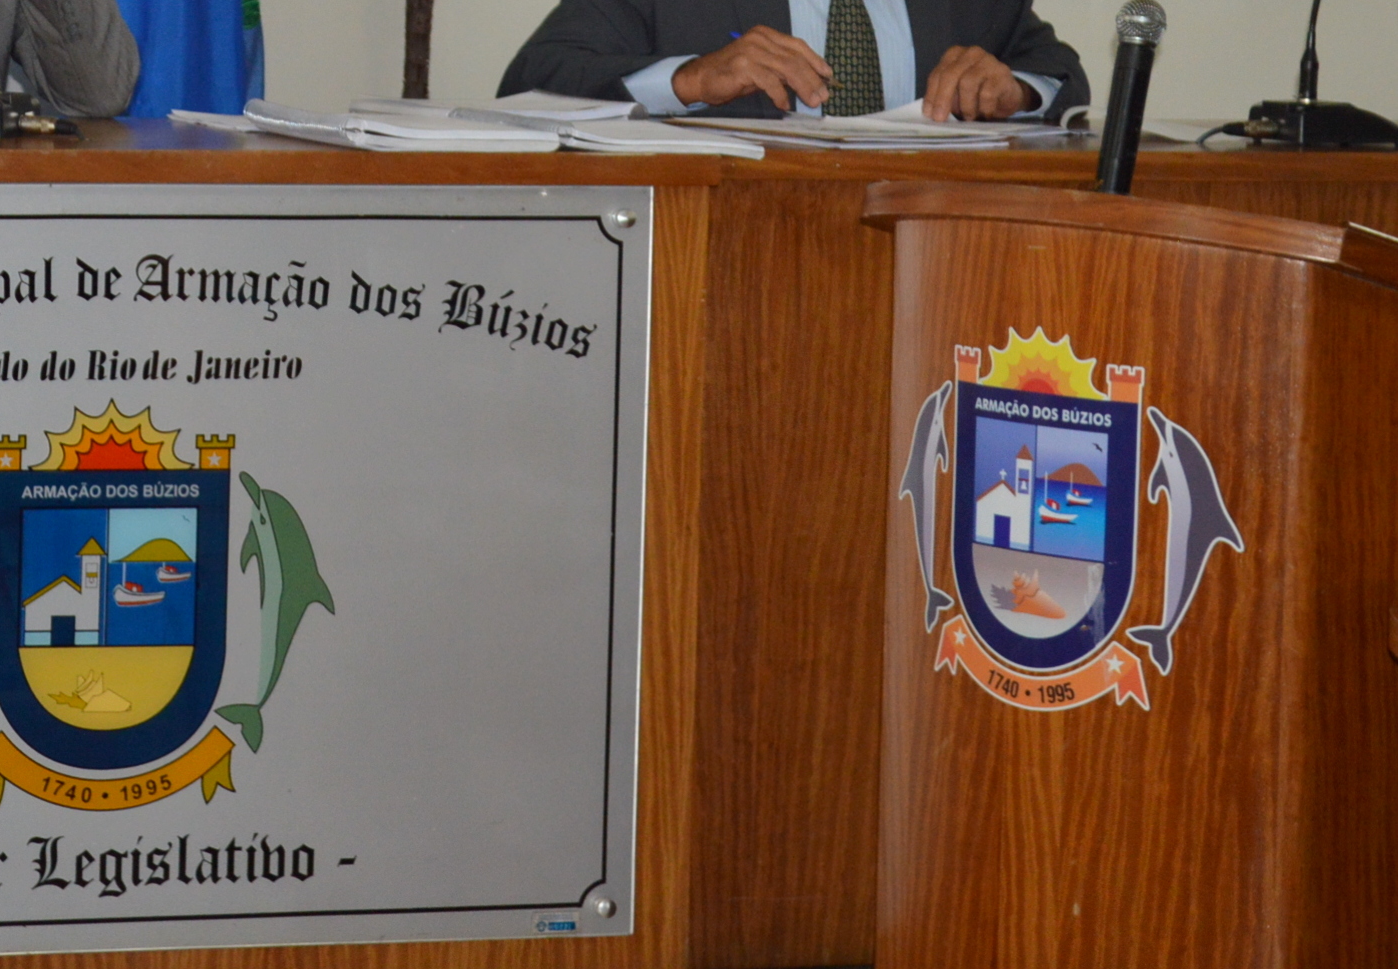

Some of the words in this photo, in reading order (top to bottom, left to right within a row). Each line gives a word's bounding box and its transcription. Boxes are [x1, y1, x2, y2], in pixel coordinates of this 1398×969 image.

[76, 257, 123, 302] de
[133, 253, 331, 323] Armação
[348, 270, 426, 321] dos
[437, 279, 598, 359] Búzios
[39, 350, 76, 382] do
[87, 349, 137, 381] Rio
[141, 349, 178, 381] de
[186, 349, 303, 385] Janeiro
[974, 397, 1030, 418] ARMAÇÃO
[1032, 405, 1059, 422] DOS
[1061, 406, 1113, 428] BÚZIOS
[21, 482, 102, 502] ARMAÇÃO
[105, 484, 139, 499] DOS
[142, 481, 200, 499] BÚZIOS
[988, 669, 1020, 698] 1740
[1038, 682, 1076, 704] 1995
[40, 776, 92, 804] 1740
[118, 773, 174, 802] 1995
[27, 832, 315, 898] Legislativo
